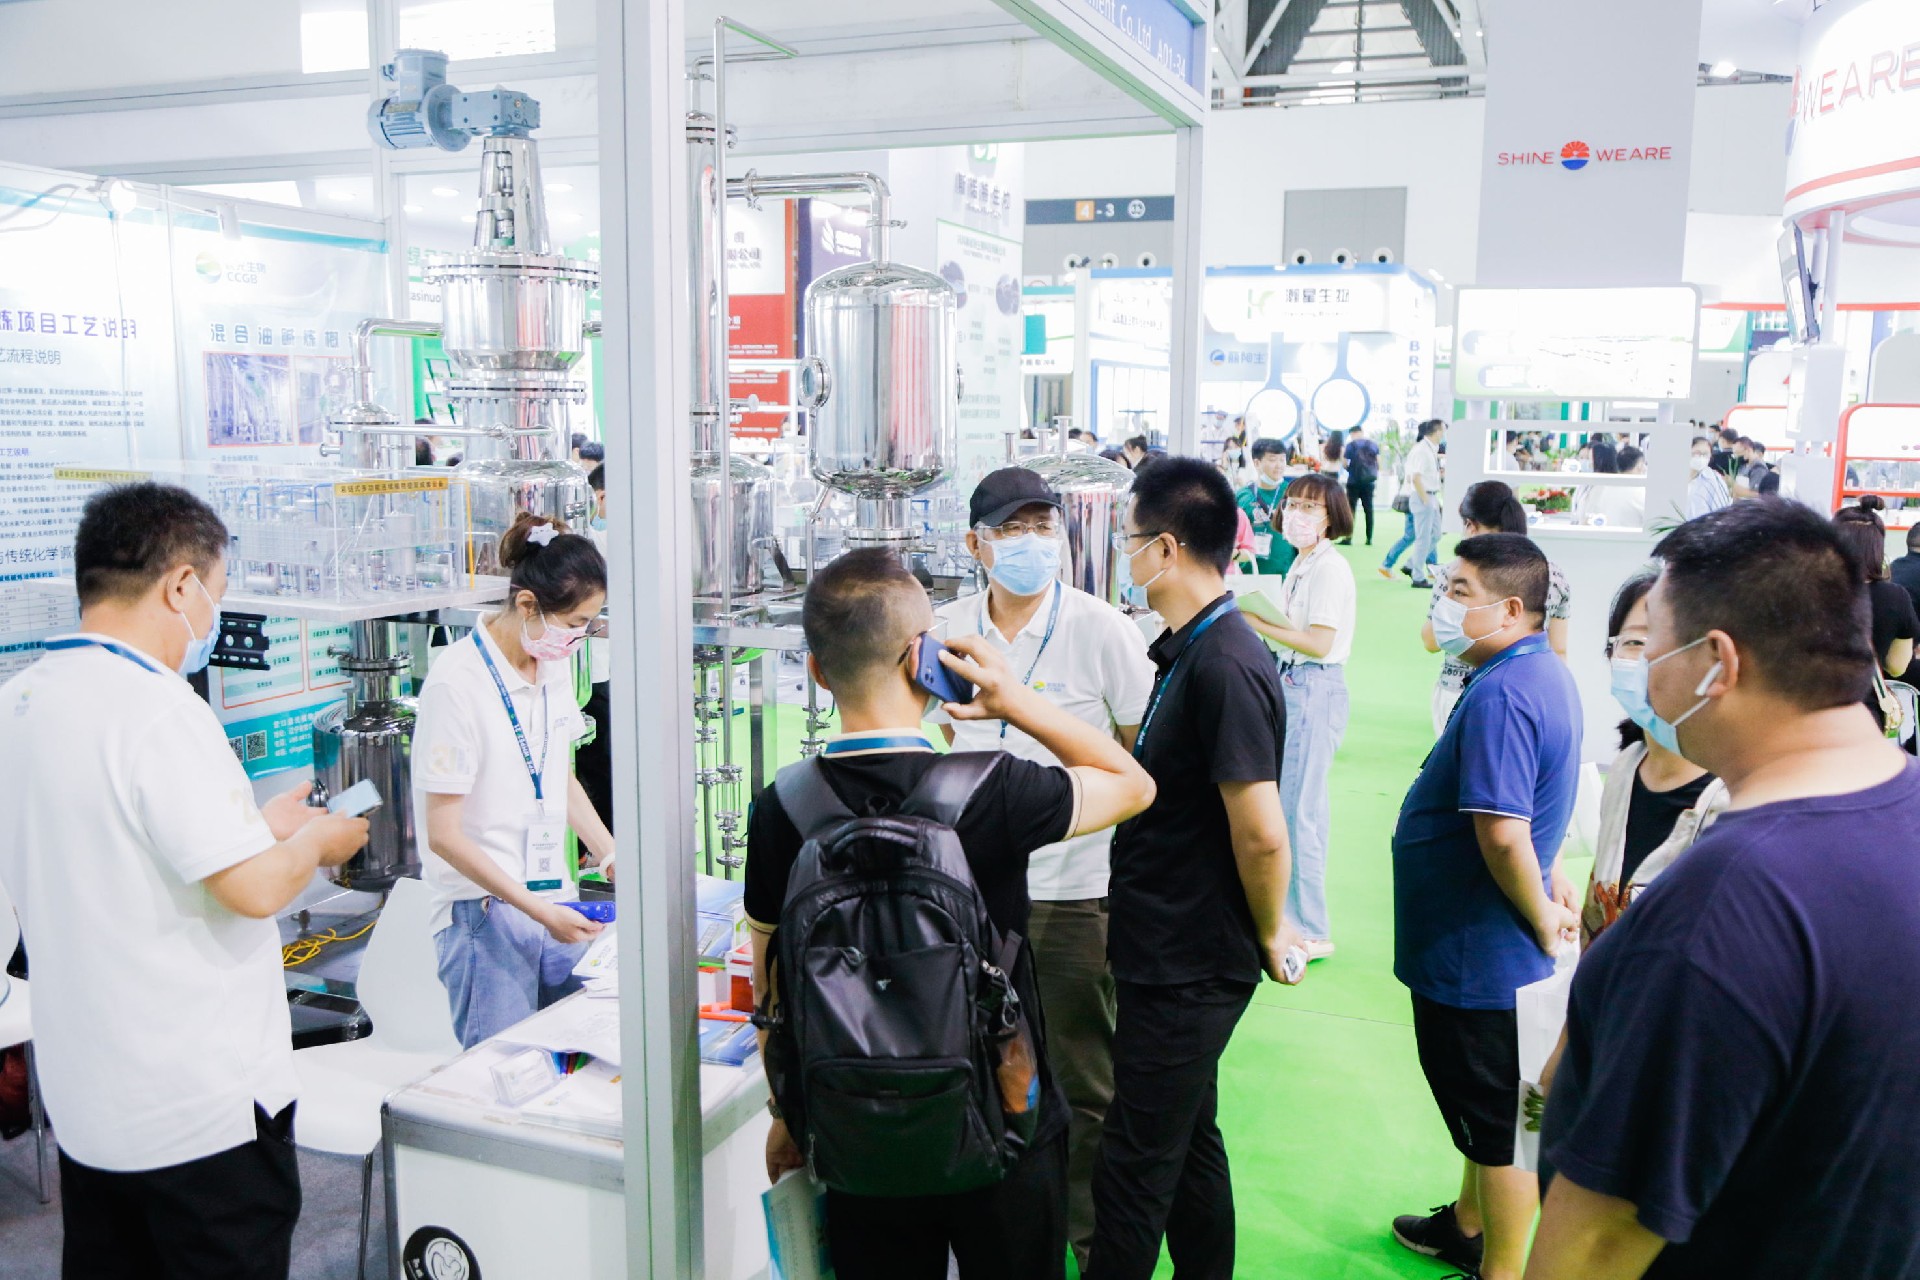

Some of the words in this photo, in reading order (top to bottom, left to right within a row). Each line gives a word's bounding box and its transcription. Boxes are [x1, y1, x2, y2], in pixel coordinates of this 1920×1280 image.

[1157, 38, 1186, 80] A01-34
[1803, 41, 1920, 124] WEARE
[1497, 151, 1555, 166] SHINE
[1595, 146, 1672, 162] WEARE
[227, 271, 258, 284] CCGB
[408, 289, 442, 303] asinuo
